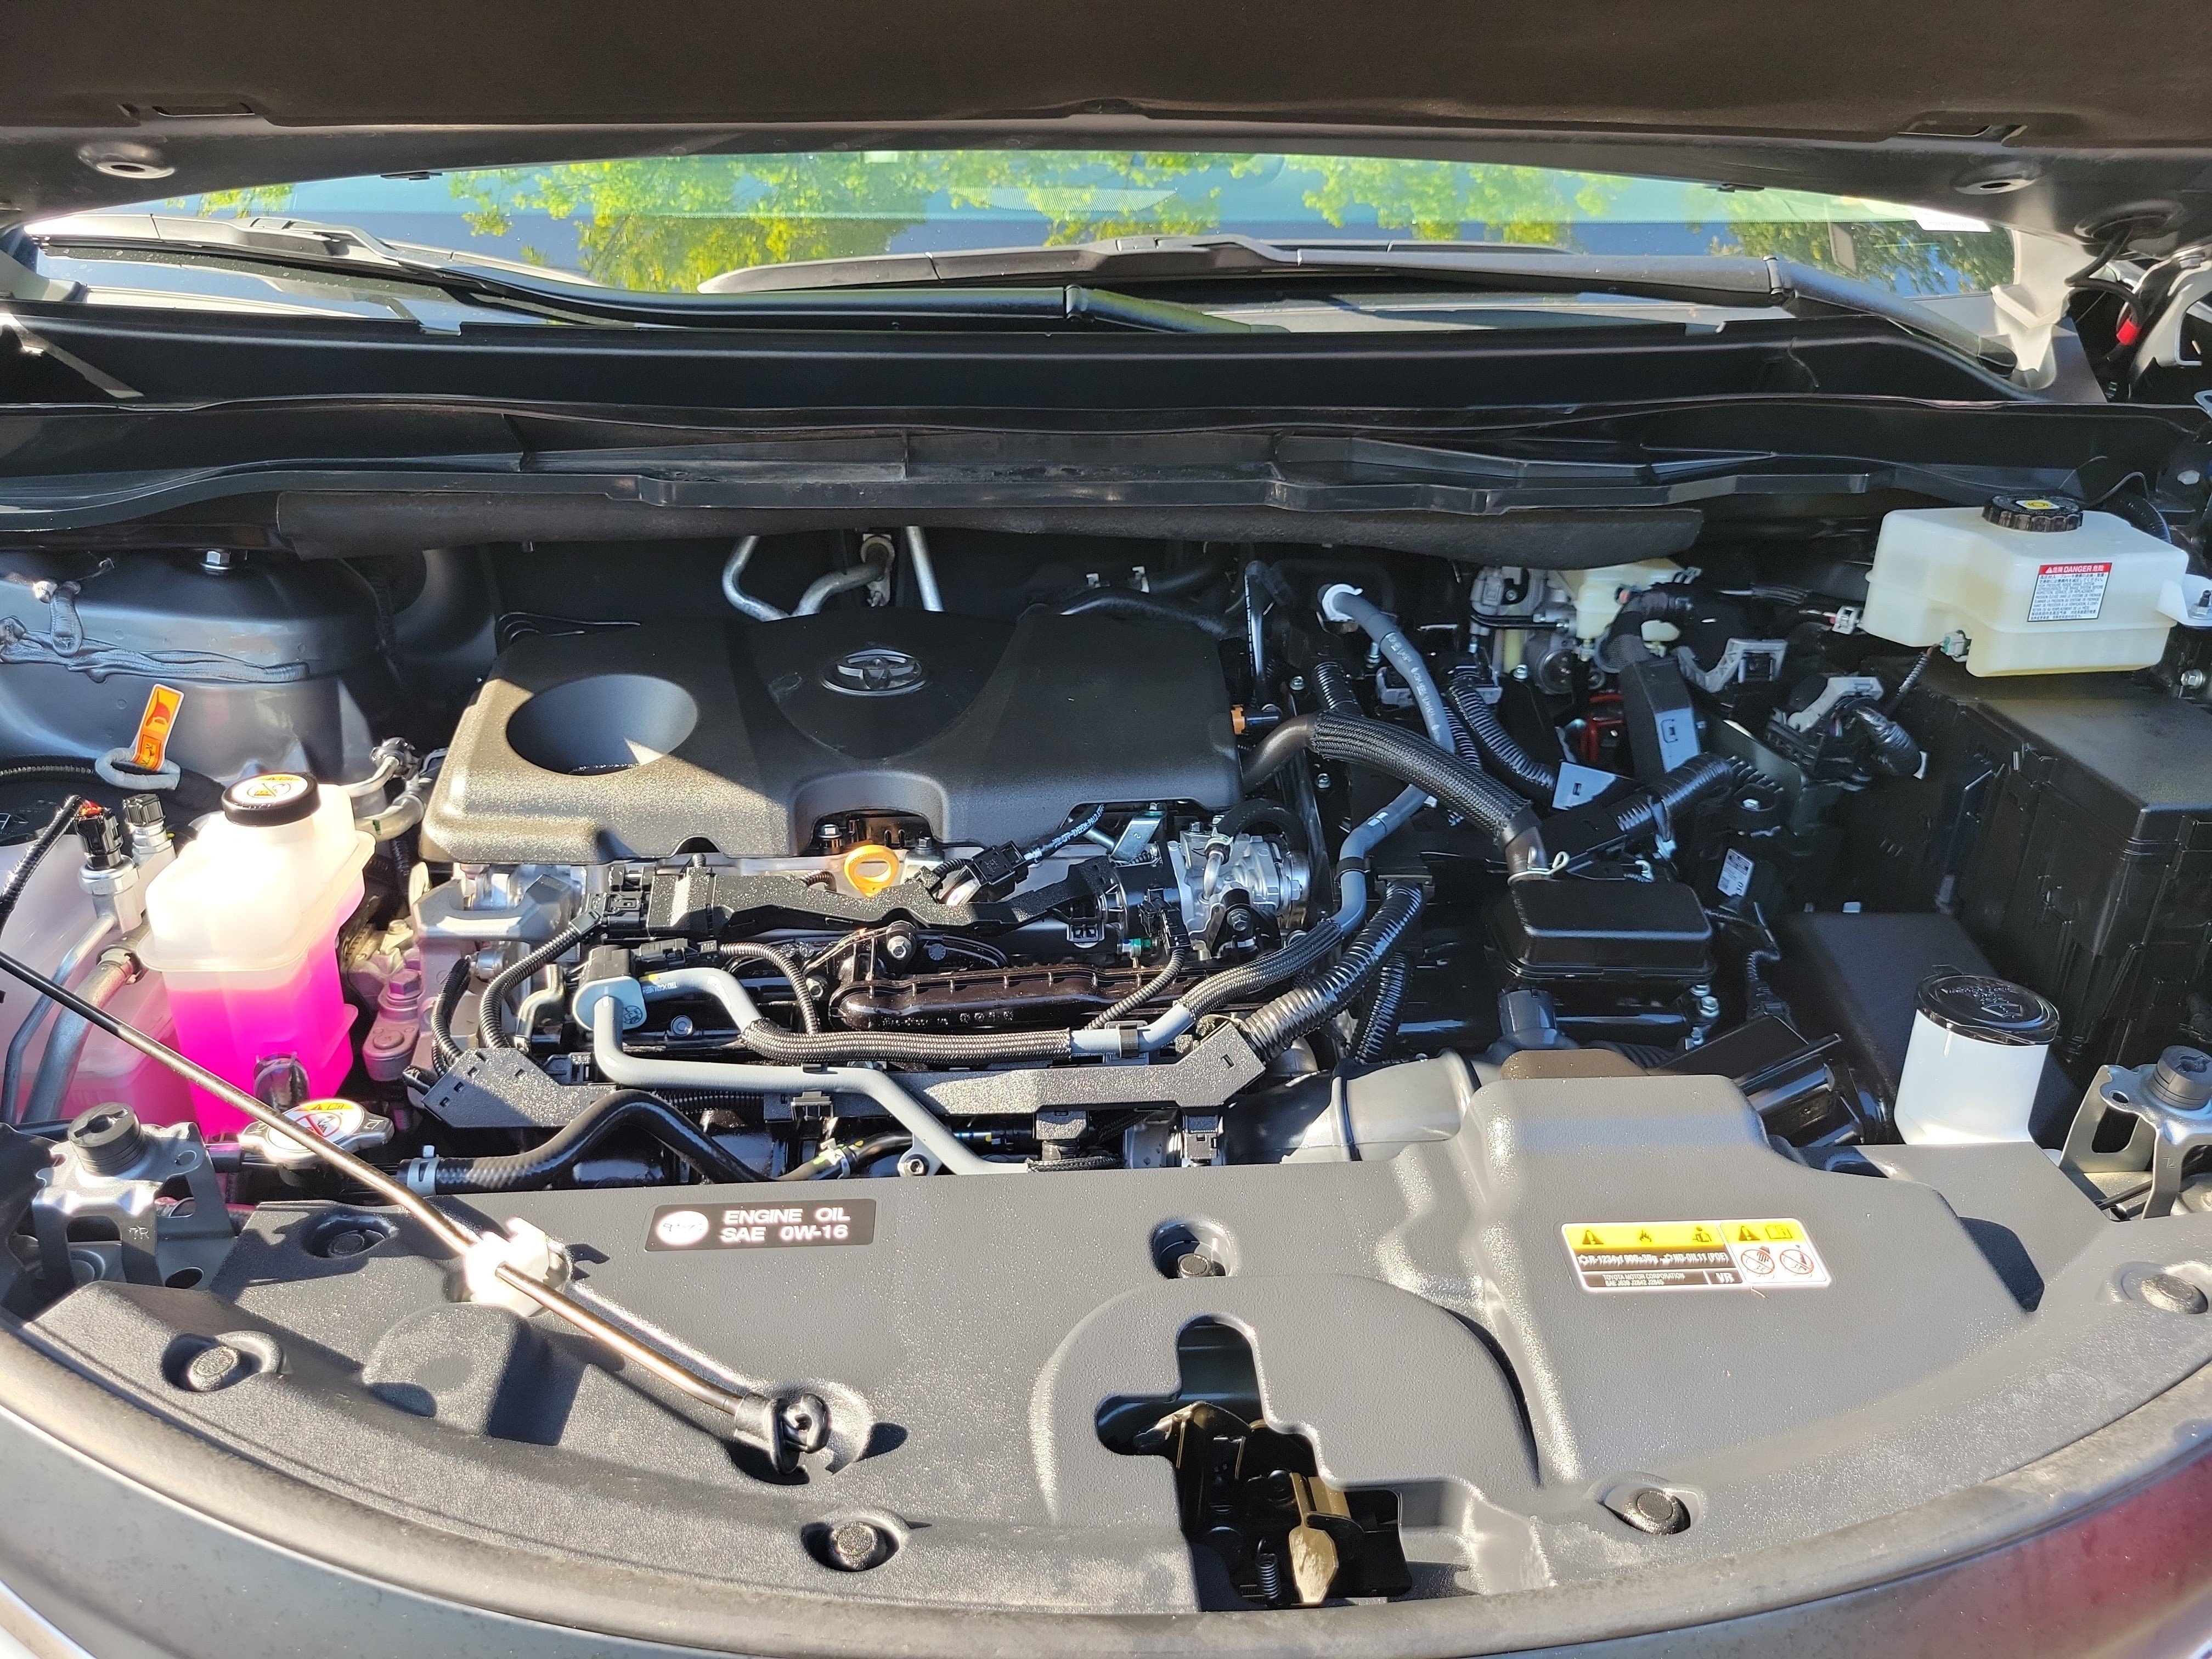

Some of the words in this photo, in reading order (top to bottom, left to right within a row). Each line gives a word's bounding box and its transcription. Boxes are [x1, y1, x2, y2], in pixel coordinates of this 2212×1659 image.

[724, 1209, 803, 1224] ENGINE
[815, 1207, 850, 1222] OIL
[720, 1227, 766, 1243] SAE
[780, 1224, 849, 1240] 0W-16
[1707, 1252, 1729, 1263] (POE)
[1715, 1272, 1735, 1283] VR
